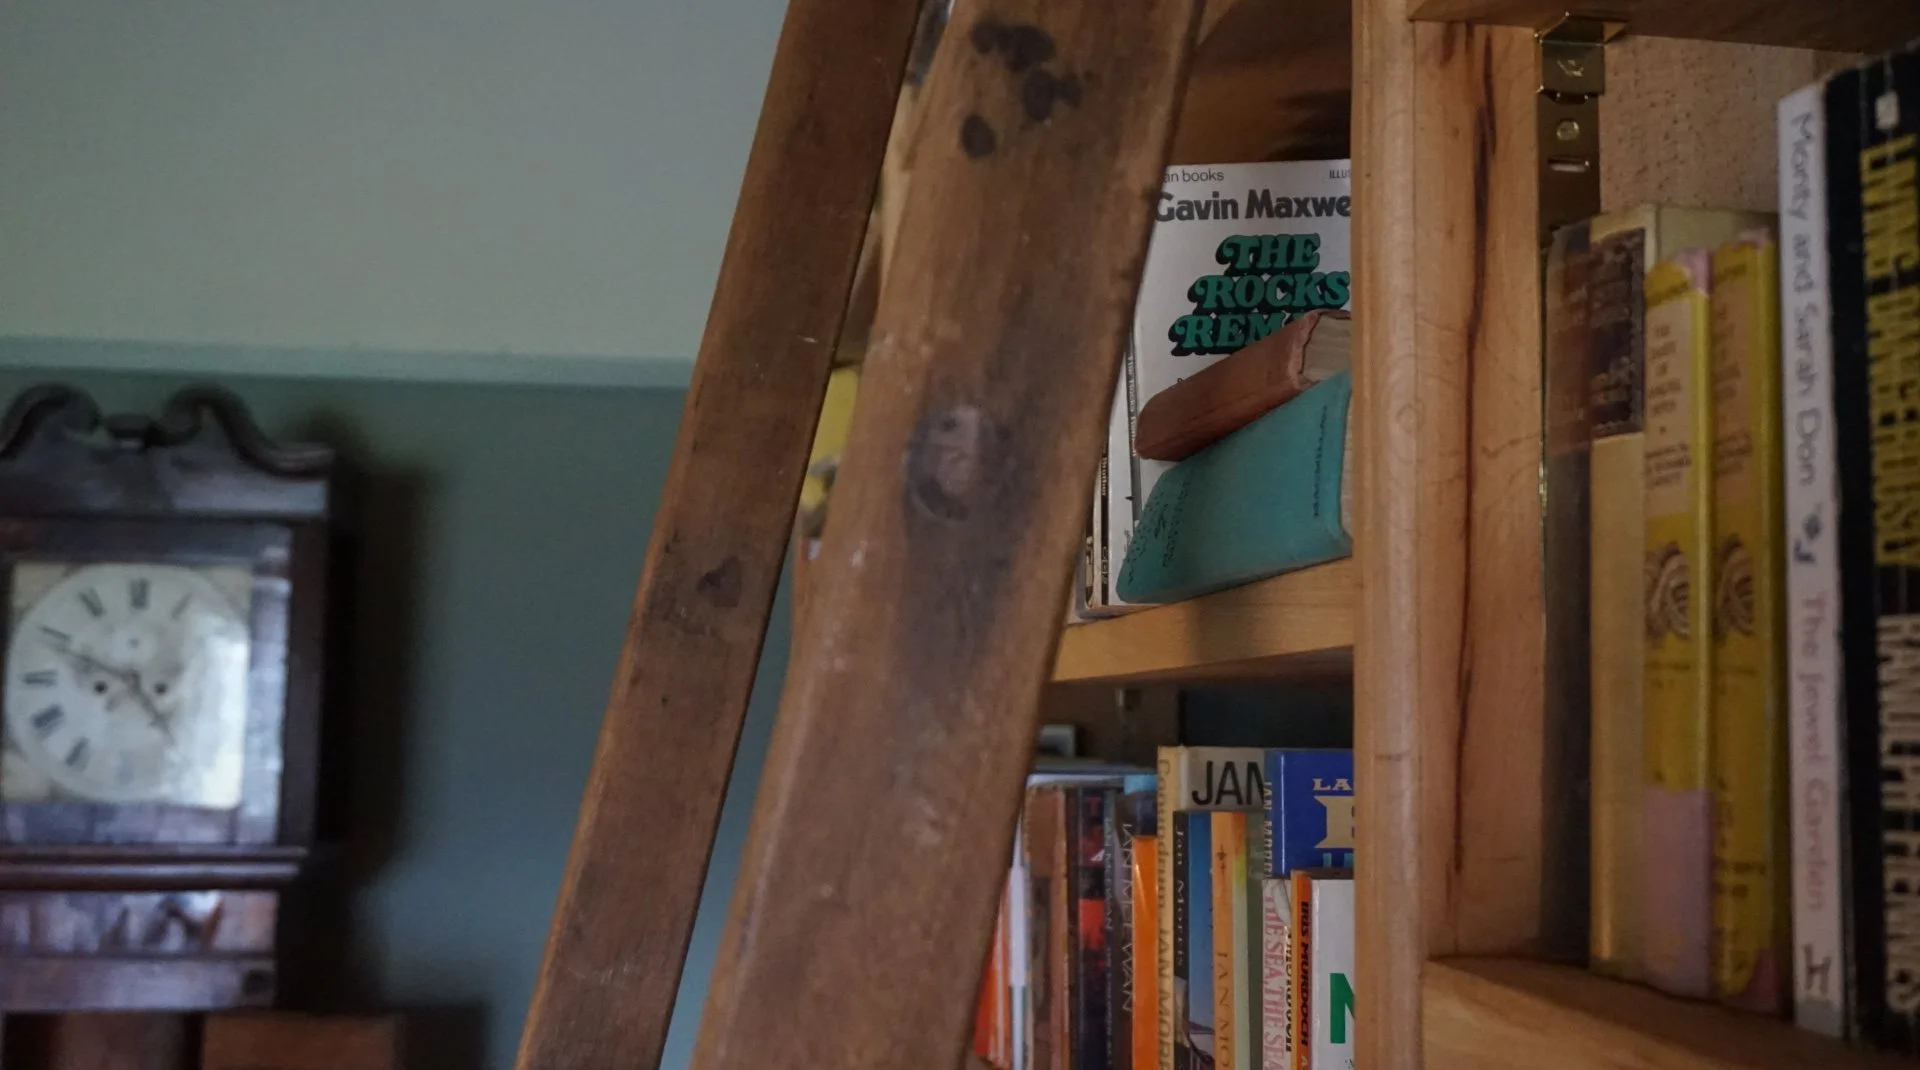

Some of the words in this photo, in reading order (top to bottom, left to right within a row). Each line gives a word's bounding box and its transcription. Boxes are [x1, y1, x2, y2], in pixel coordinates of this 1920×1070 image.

[1182, 168, 1224, 183] books
[1787, 111, 1815, 221] Monty
[1155, 191, 1239, 222] Gavin
[1245, 189, 1351, 220] Maxwe
[1215, 233, 1320, 276] THE
[1792, 232, 1819, 294] and
[1187, 271, 1350, 315] ROCKS
[1794, 303, 1819, 397] Sarah
[1797, 407, 1823, 486] Don
[1801, 591, 1827, 658] The
[1300, 941, 1310, 1047] MURDOCH
